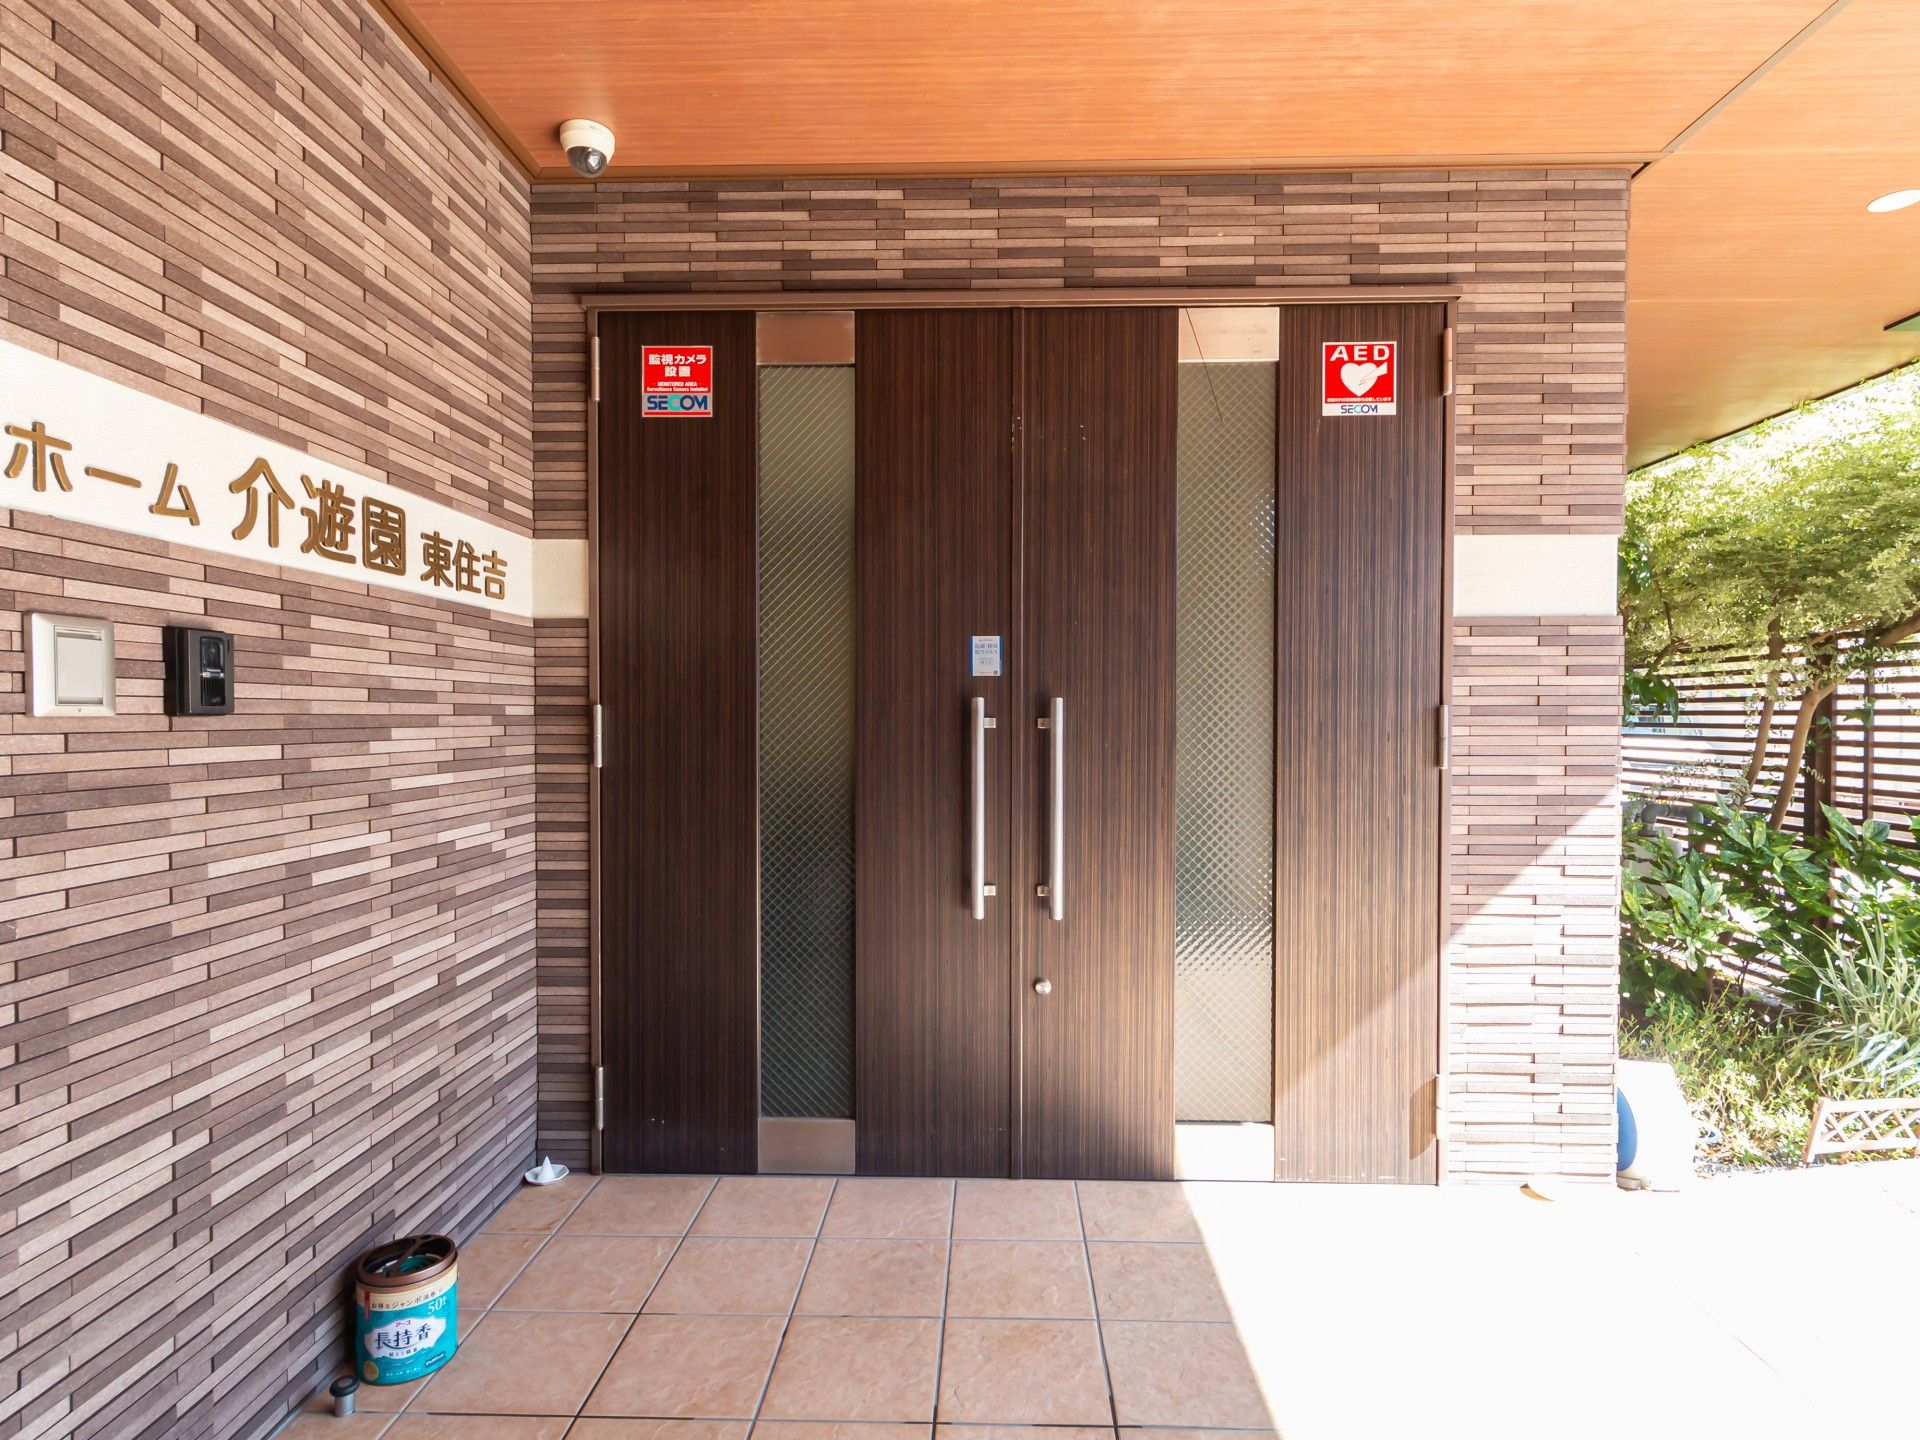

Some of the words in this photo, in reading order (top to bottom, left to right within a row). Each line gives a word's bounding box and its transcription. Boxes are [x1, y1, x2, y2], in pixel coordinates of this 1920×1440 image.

[648, 353, 707, 365] 監視カメラ
[1329, 345, 1390, 361] AED
[664, 366, 691, 377] 設置
[646, 394, 708, 411] SECOM
[1340, 404, 1378, 414] SECOM
[4, 421, 201, 527] ホーム
[228, 457, 407, 576] 介遊園
[419, 530, 509, 600] 東住吉
